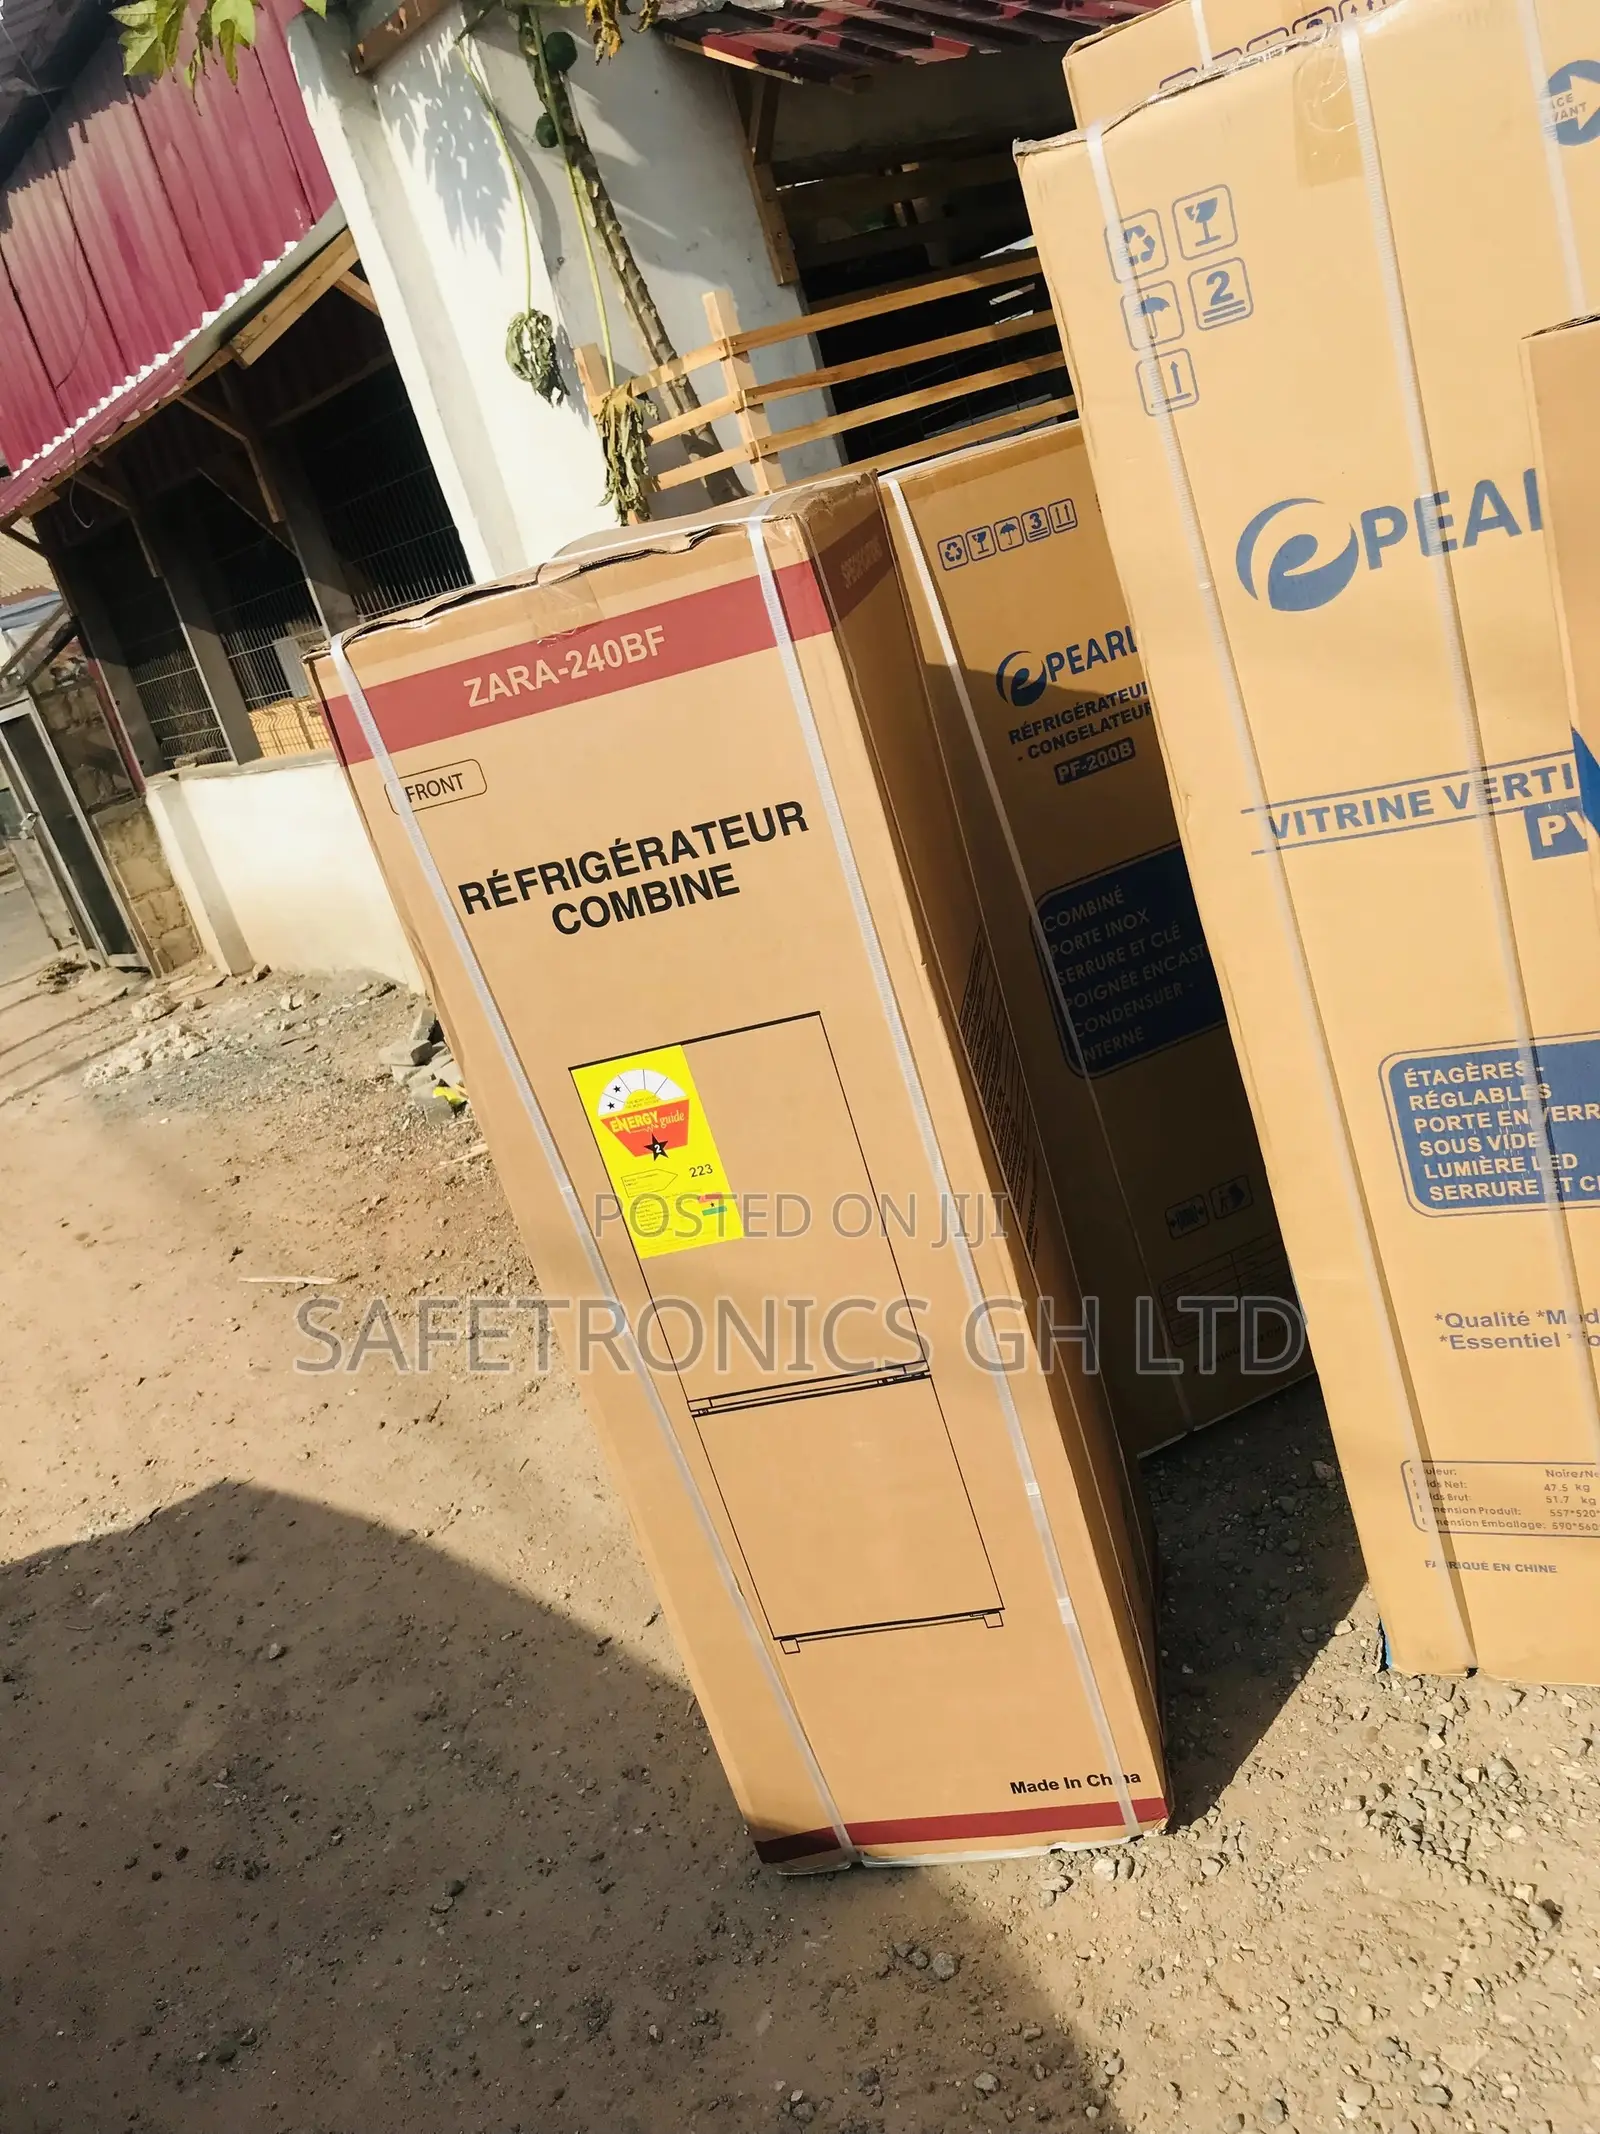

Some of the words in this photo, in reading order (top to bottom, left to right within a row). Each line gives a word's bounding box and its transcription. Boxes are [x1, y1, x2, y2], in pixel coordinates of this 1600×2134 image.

[1206, 271, 1234, 305] 2
[1030, 512, 1042, 530] 3
[463, 624, 666, 709] ZARA-240BF
[1057, 741, 1132, 782] PF-200B
[404, 773, 463, 803] FRONT
[1268, 789, 1435, 840] VITRINE
[458, 800, 809, 916] RÉFRIGÉRATEUR
[552, 863, 740, 936] COMBINE
[1043, 885, 1126, 932] COMBINÉ
[1051, 927, 1101, 960] PORTE
[1105, 907, 1150, 939] INOX
[1058, 947, 1126, 987] SERRURE
[1129, 939, 1146, 959] ET
[1151, 920, 1181, 948] CLÉ
[1083, 1026, 1145, 1062] NTERNE
[610, 1110, 658, 1134] ENERGY
[660, 1110, 685, 1128] guide
[1414, 1112, 1492, 1134] PORTE
[1498, 1109, 1530, 1127] EN
[654, 1144, 662, 1153] 2
[1419, 1136, 1482, 1157] SOUS
[1487, 1132, 1543, 1151] VIDE
[689, 1163, 713, 1178] 223
[1424, 1155, 1527, 1180] LUMIÈRE
[1429, 1179, 1539, 1201] SERRURE
[1493, 1562, 1511, 1572] EN
[1515, 1563, 1557, 1573] CHINE
[1010, 1780, 1060, 1794] Made
[1064, 1777, 1082, 1789] In
[1087, 1773, 1141, 1787] Chna
